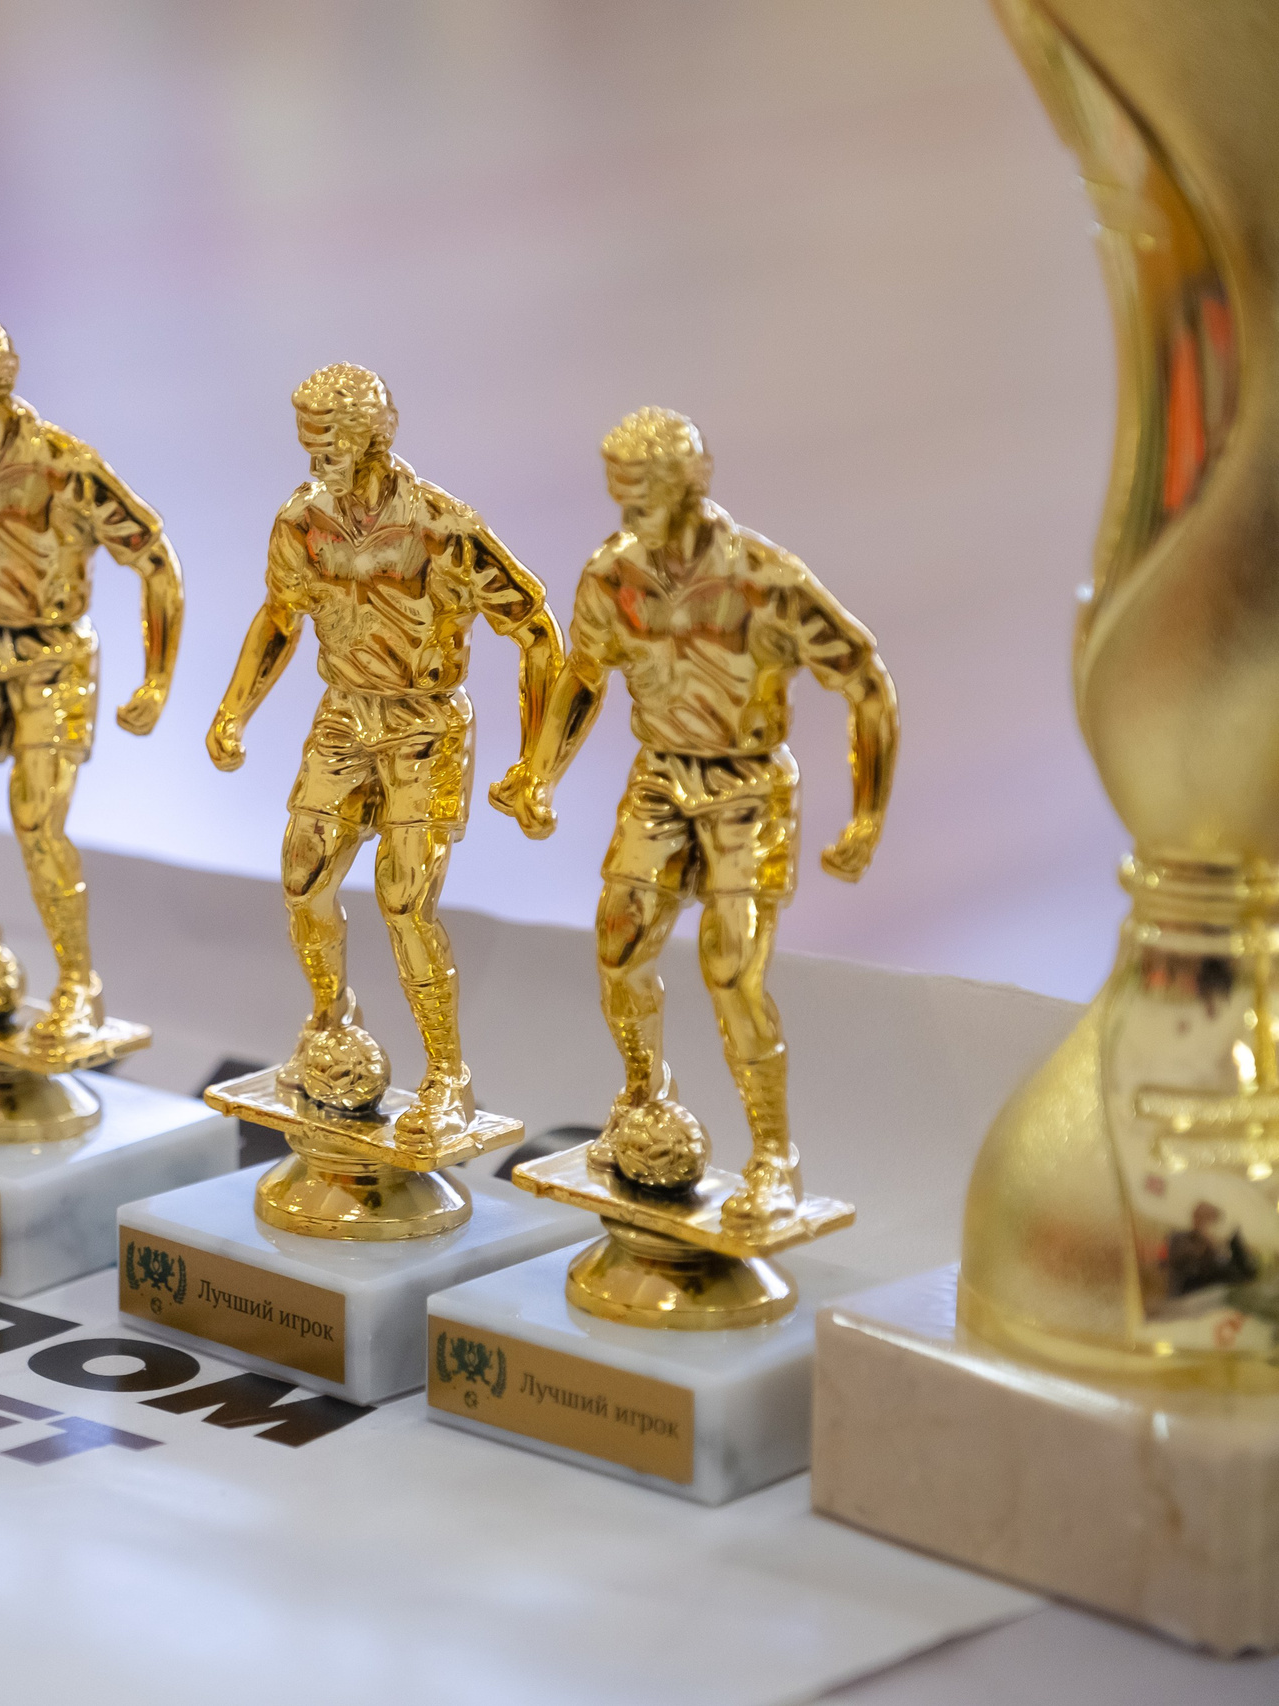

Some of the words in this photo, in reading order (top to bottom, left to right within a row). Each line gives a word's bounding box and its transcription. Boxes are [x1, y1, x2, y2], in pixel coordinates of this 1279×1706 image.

[198, 1278, 274, 1323] Лучший
[279, 1309, 334, 1343] игрок
[519, 1371, 609, 1419] Лучший
[615, 1404, 680, 1440] игрок
